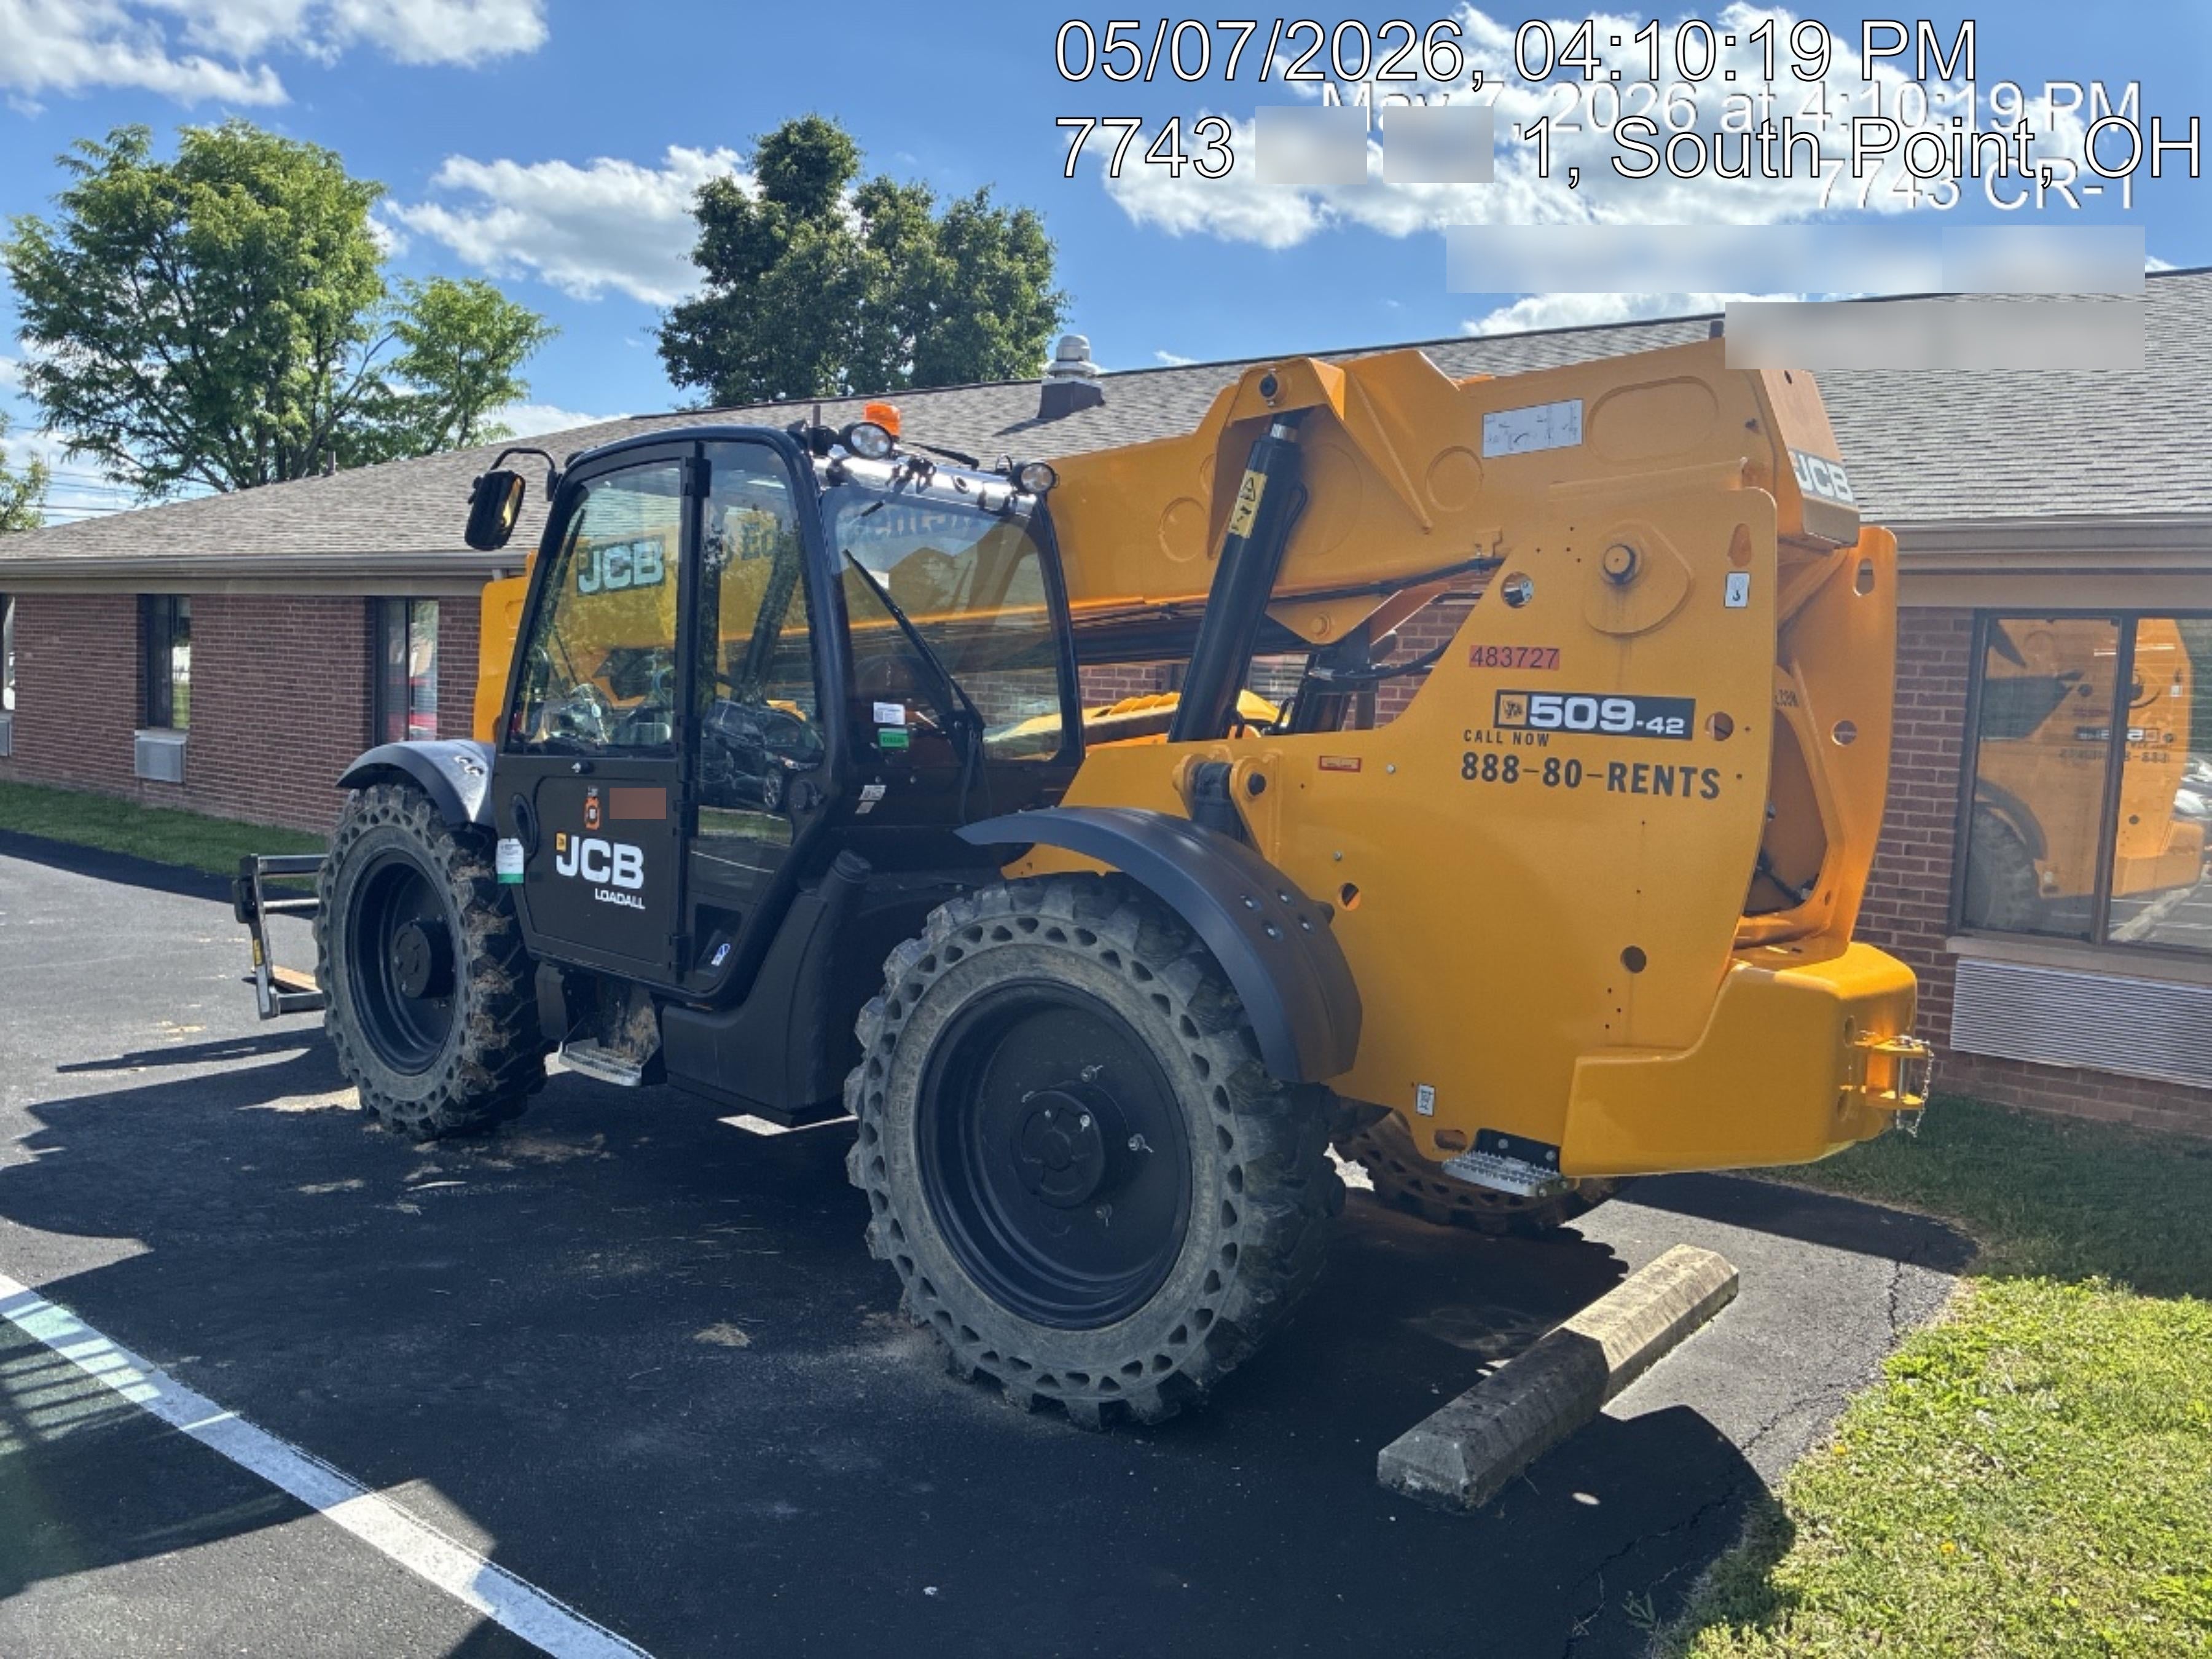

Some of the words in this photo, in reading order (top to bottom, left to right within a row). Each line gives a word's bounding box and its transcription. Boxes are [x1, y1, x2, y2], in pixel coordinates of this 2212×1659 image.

[1794, 453, 1854, 503] JCB
[578, 539, 664, 594] JCB
[1470, 646, 1559, 670] 483727
[1529, 696, 1685, 735] 509-42
[1463, 729, 1504, 744] CALL
[1512, 732, 1550, 748] NOW
[1461, 751, 1720, 799] 888-80-RENTS
[555, 834, 645, 890] JCB
[594, 887, 646, 910] LOADALL
